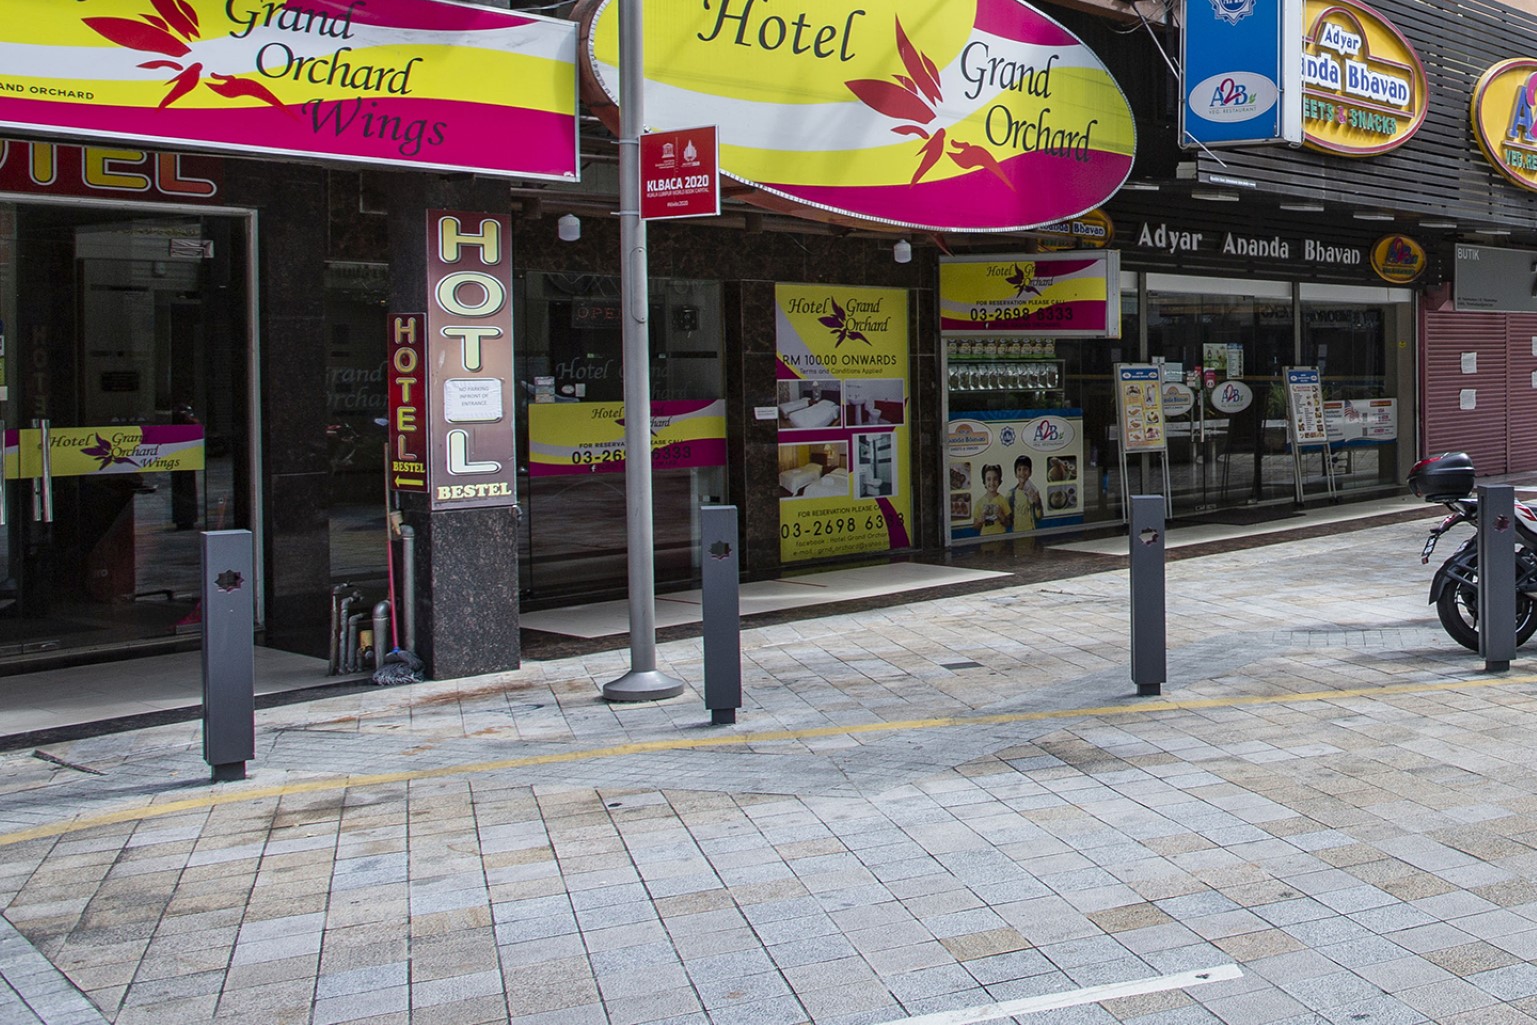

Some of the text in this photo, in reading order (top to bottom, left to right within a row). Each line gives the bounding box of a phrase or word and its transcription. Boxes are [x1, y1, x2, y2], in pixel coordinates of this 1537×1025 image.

[1324, 28, 1359, 50] Adyar
[257, 43, 422, 95] Orchard
[961, 41, 1059, 100] Grand
[0, 82, 95, 100] AND ORCHARD
[1348, 64, 1408, 101] Bhavan
[1209, 78, 1249, 107] A2B
[301, 96, 446, 156] Wings
[1336, 105, 1347, 124] &
[1350, 108, 1397, 134] SNACKS
[984, 104, 1098, 163] Orchard
[647, 174, 709, 192] KLBACA 2020
[1073, 222, 1105, 235] Bhavan
[1138, 222, 1361, 265] Adyar Ananda Bhavan
[1457, 248, 1480, 261] BUTIK
[986, 264, 1014, 277] Hotel
[576, 307, 622, 320] OPE
[787, 297, 830, 314] Hotel
[846, 297, 884, 316] Grand
[970, 307, 1030, 321] 03-2698
[845, 316, 892, 333] Orchard
[783, 355, 897, 366] RM 100.00 ONWARDS
[394, 317, 418, 460] HOTEL
[591, 406, 624, 419] Hotel
[50, 433, 94, 447] Hotel
[595, 441, 625, 449] RESERVA
[110, 443, 161, 457] Orchard
[571, 449, 626, 465] 03-26
[140, 457, 181, 470] Wings
[393, 461, 426, 474] BESTEL
[437, 482, 512, 501] BESTEL
[812, 507, 851, 517] RESERVATION
[851, 505, 872, 513] PLEASE
[780, 517, 856, 539] 03-2698
